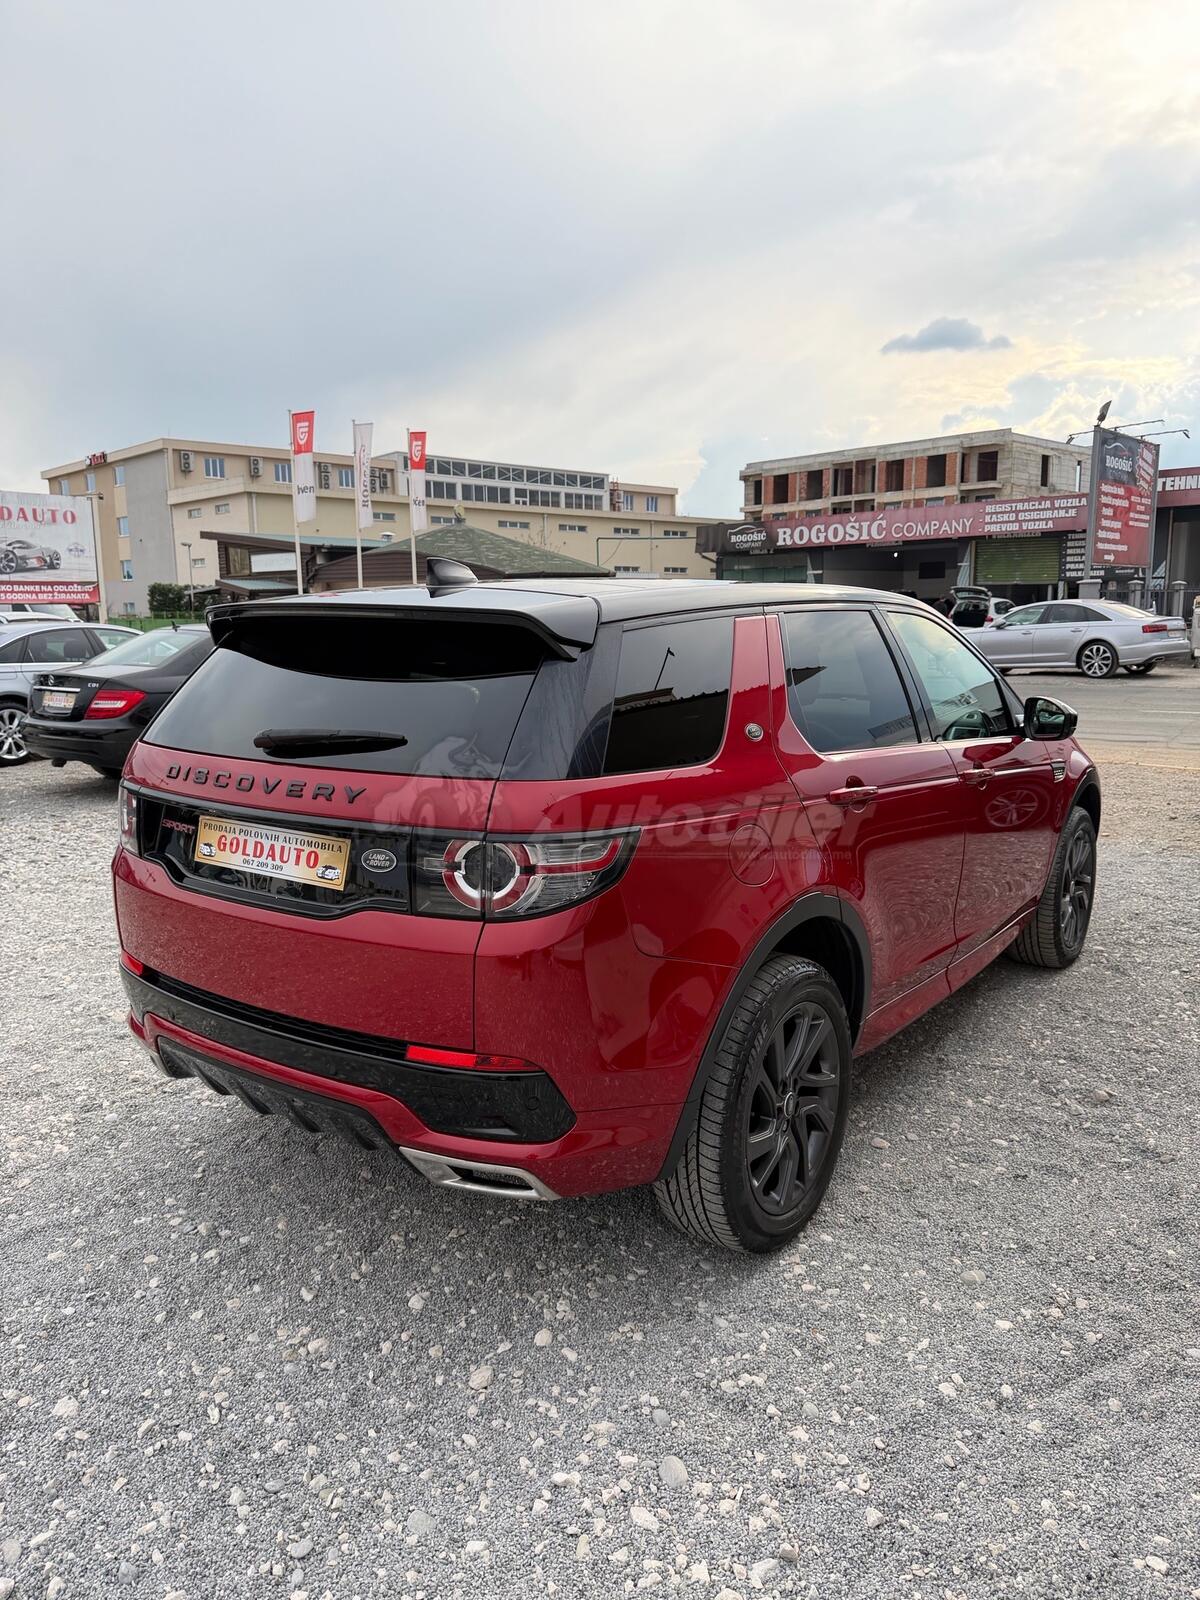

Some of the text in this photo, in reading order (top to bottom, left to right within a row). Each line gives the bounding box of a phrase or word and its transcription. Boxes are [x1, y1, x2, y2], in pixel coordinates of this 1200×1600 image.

[985, 501, 1051, 513] REGISTRACIJA
[1054, 497, 1087, 507] VOZILA
[984, 509, 1078, 523] KASKO OSIGURANJE
[776, 514, 974, 546] ROGOŠIĆ COMPANY
[984, 520, 1054, 532] PREVOD VOZILA
[730, 531, 767, 543] ROGOŠIĆ
[735, 541, 762, 549] COMPANY
[54, 592, 90, 600] ŽIRANATA
[166, 764, 367, 805] DISCOVERY
[161, 819, 195, 834] SPORT
[203, 822, 343, 853] PRODAJA POLOVNIH AUTOMOBILA
[217, 834, 320, 869] GOLDAUTO
[369, 853, 386, 861] LAND
[242, 858, 284, 872] 067 209 309
